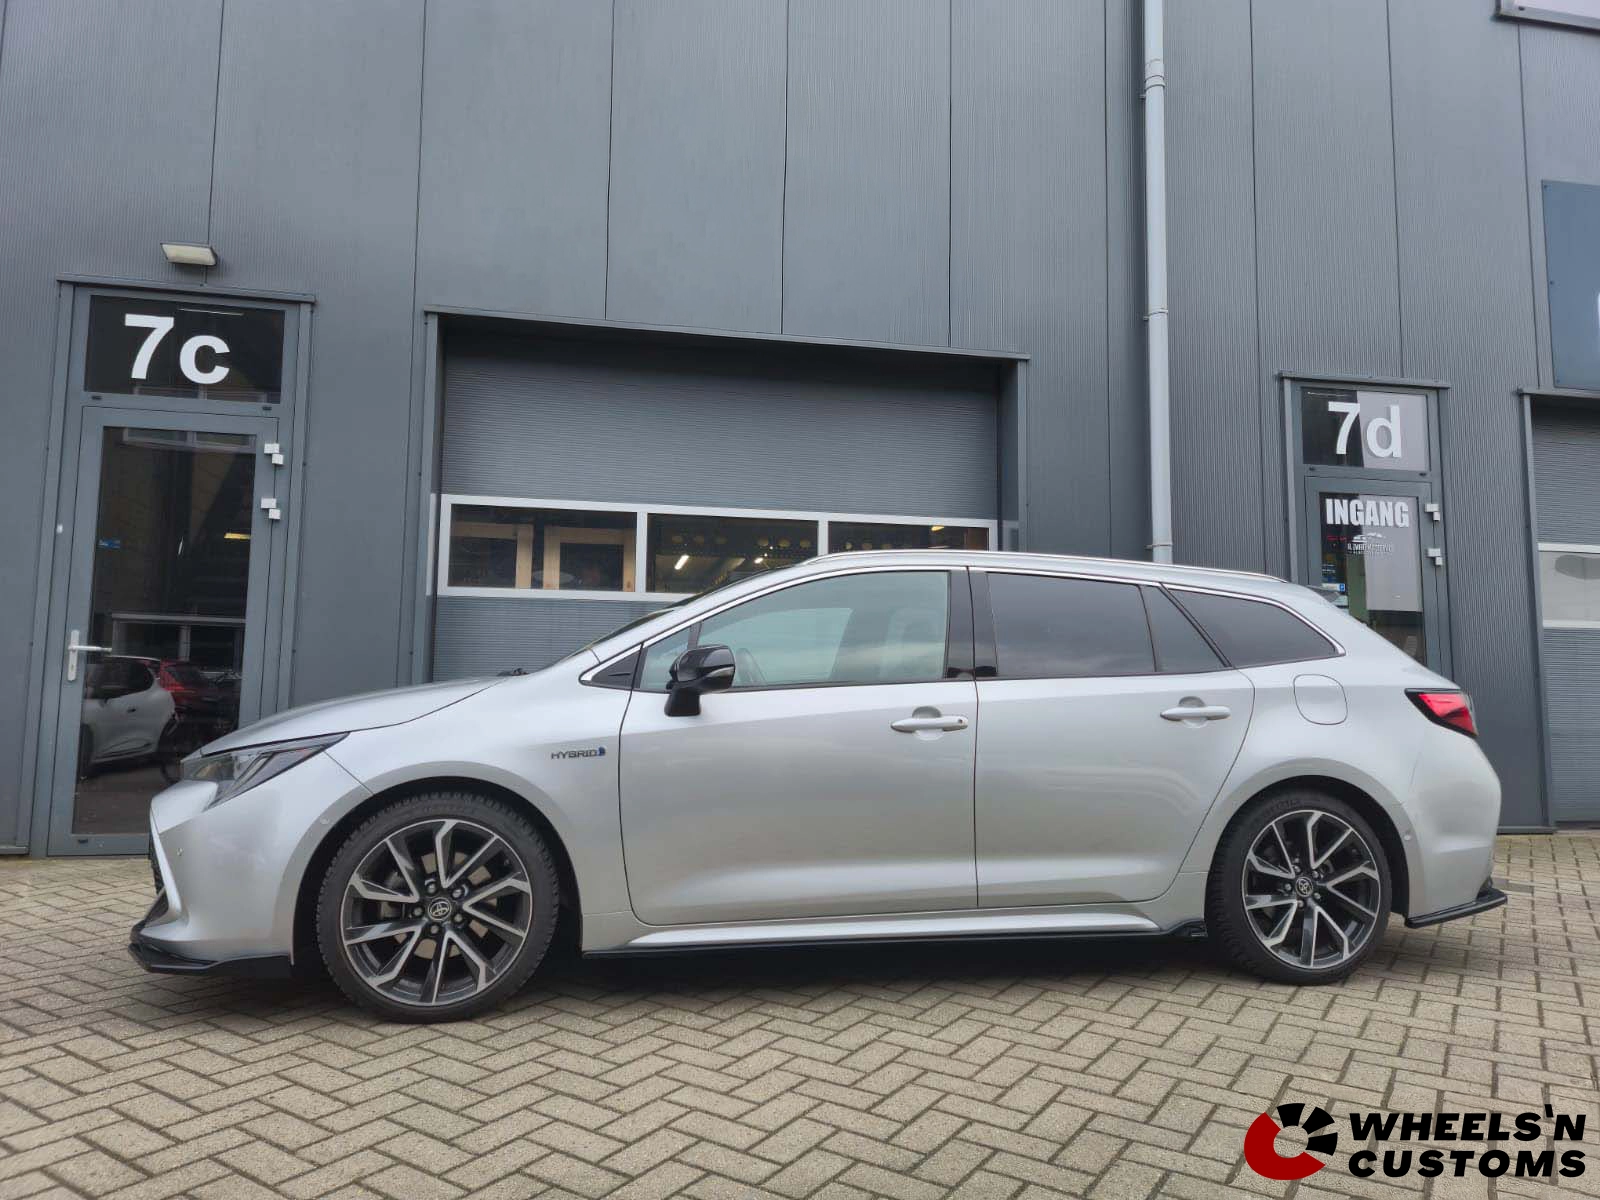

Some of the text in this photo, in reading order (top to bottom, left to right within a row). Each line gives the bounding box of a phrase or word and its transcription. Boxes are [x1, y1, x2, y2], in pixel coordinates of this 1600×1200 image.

[125, 313, 230, 384] 7c
[1328, 401, 1401, 458] 7d
[1325, 498, 1409, 528] INGANG
[551, 749, 598, 759] HYBRID
